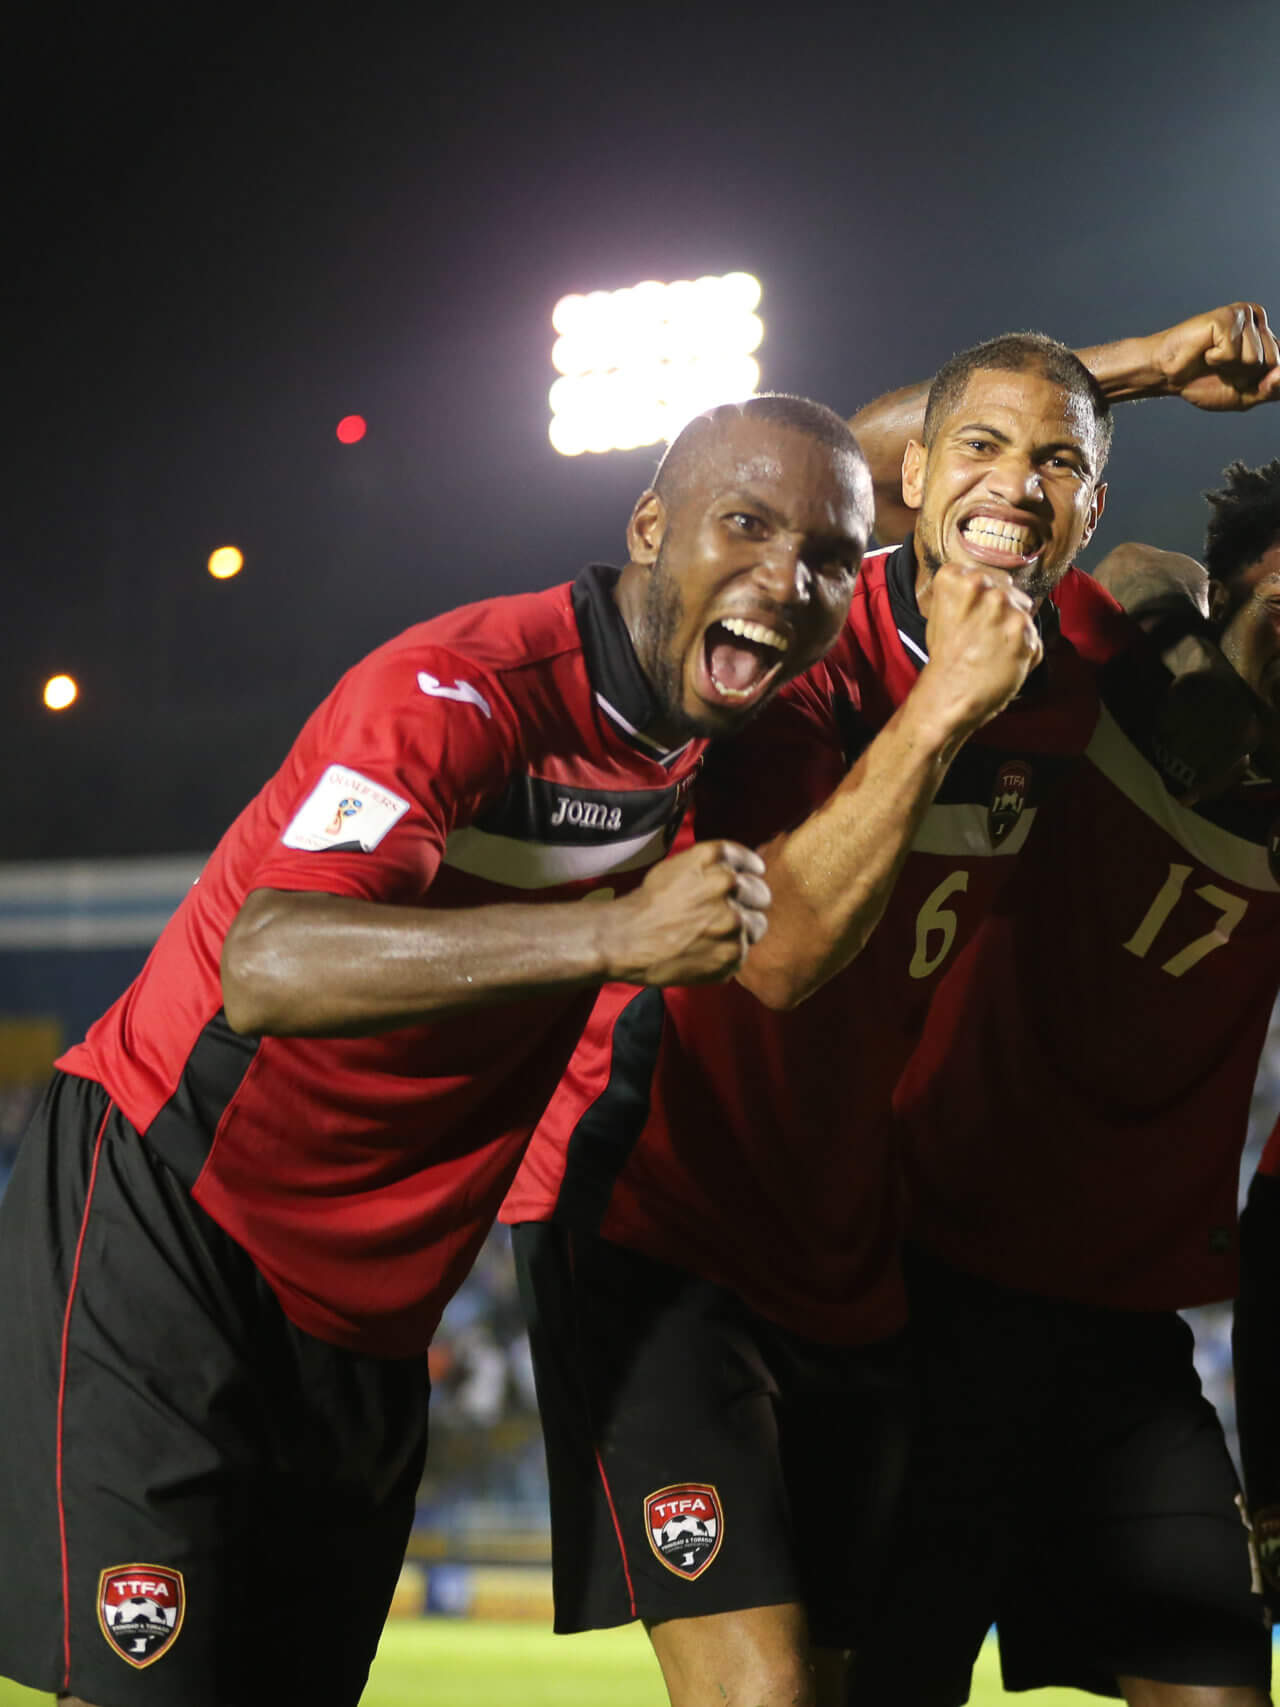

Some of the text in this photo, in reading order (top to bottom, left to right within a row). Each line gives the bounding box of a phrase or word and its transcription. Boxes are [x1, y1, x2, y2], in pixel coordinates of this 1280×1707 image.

[551, 797, 622, 831] Joma
[908, 870, 969, 979] 6
[1122, 863, 1249, 978] 17
[655, 1497, 707, 1518] TTFA
[113, 1580, 169, 1597] TTFA
